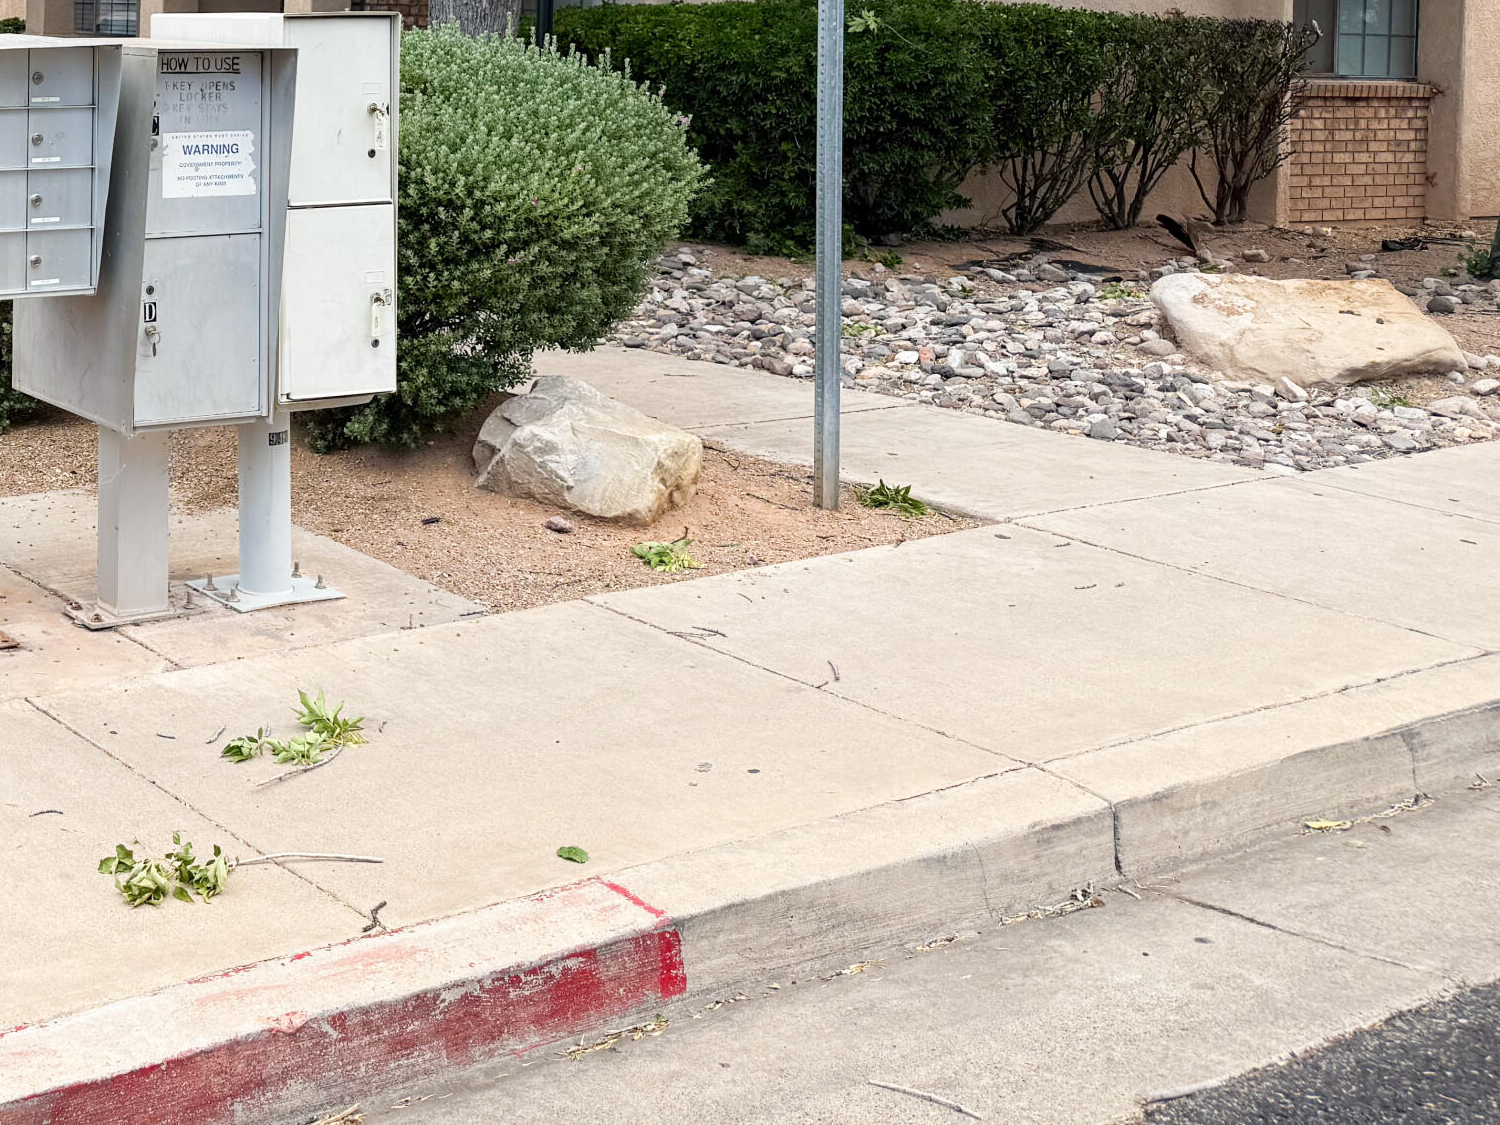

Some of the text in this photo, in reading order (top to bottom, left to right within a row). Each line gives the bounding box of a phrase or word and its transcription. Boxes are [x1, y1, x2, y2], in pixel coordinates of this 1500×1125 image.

[161, 56, 240, 71] HOW TO USE
[180, 92, 221, 102] LOCKER
[182, 143, 239, 156] WARNING
[145, 303, 156, 321] D
